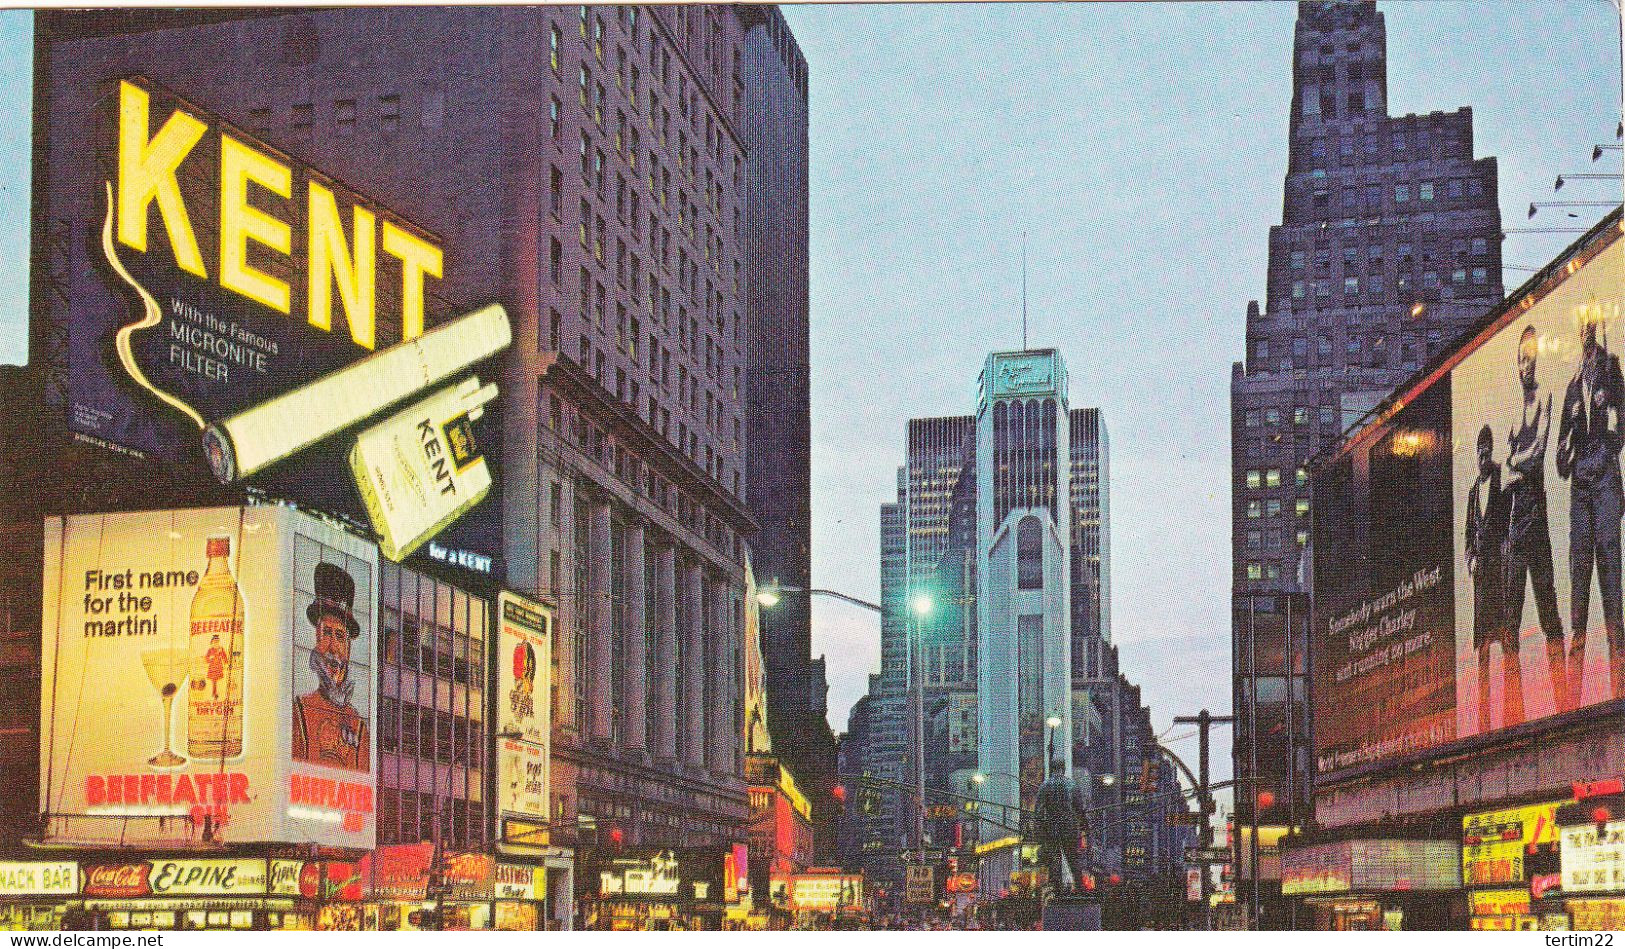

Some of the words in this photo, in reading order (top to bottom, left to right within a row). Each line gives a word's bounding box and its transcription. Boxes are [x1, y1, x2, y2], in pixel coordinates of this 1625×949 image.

[118, 79, 444, 351] KENT
[171, 297, 202, 324] With
[206, 312, 227, 334] the
[231, 321, 279, 355] Famous
[171, 320, 268, 375] MICRONITE
[170, 344, 228, 383] FILTER
[418, 418, 457, 496] KENT
[458, 549, 491, 573] KENT
[85, 569, 133, 591] First
[139, 570, 200, 589] name
[1398, 580, 1413, 599] the
[84, 592, 113, 614] for
[118, 592, 153, 612] the
[84, 614, 158, 638] martini
[191, 619, 243, 635] BEEFEATER
[87, 774, 250, 806] BEEFEATER
[290, 774, 374, 813] BEEFEATER
[43, 867, 72, 889] BAR
[154, 863, 237, 892] ELPINE
